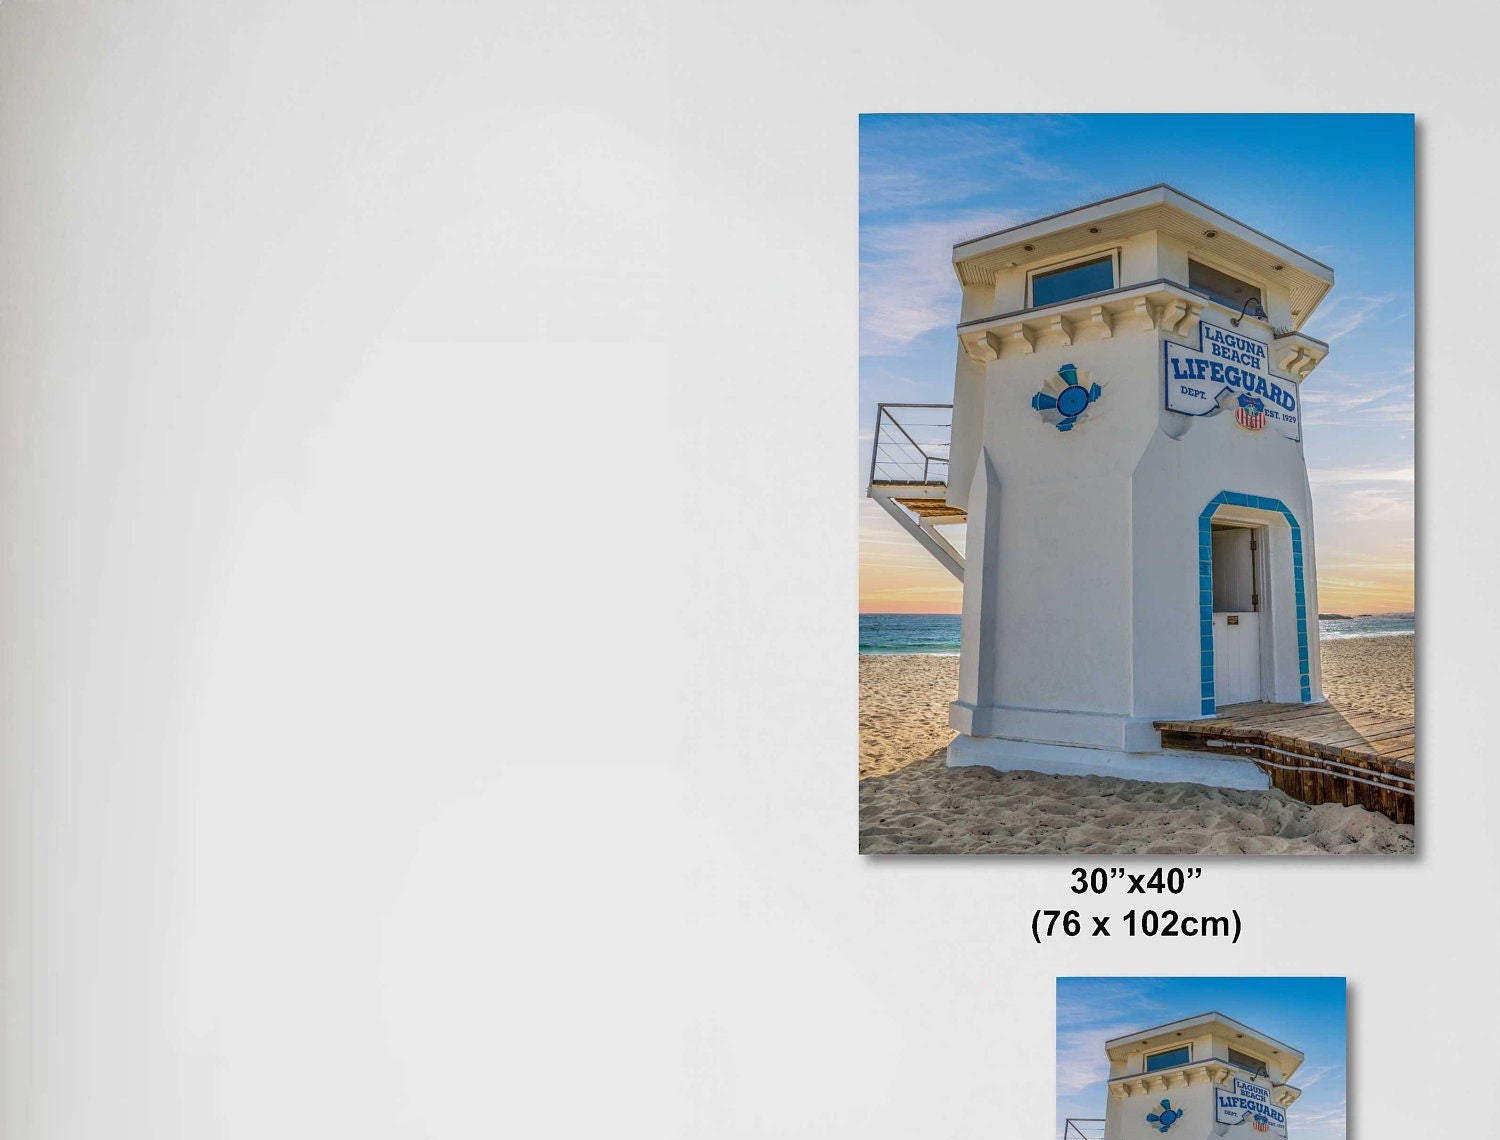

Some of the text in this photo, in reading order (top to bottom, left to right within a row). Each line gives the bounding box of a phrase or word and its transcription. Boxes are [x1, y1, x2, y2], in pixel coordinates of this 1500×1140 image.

[1205, 327, 1265, 358] LAGUNA
[1212, 343, 1260, 369] BEACH
[1171, 358, 1296, 411] LIFEGUARD
[1181, 385, 1207, 400] DEPT.
[1264, 409, 1280, 420] EST.
[1237, 1082, 1268, 1097] LAGUNA
[1241, 1089, 1266, 1102] BEACH
[1219, 1096, 1285, 1123] LIFEGUARD
